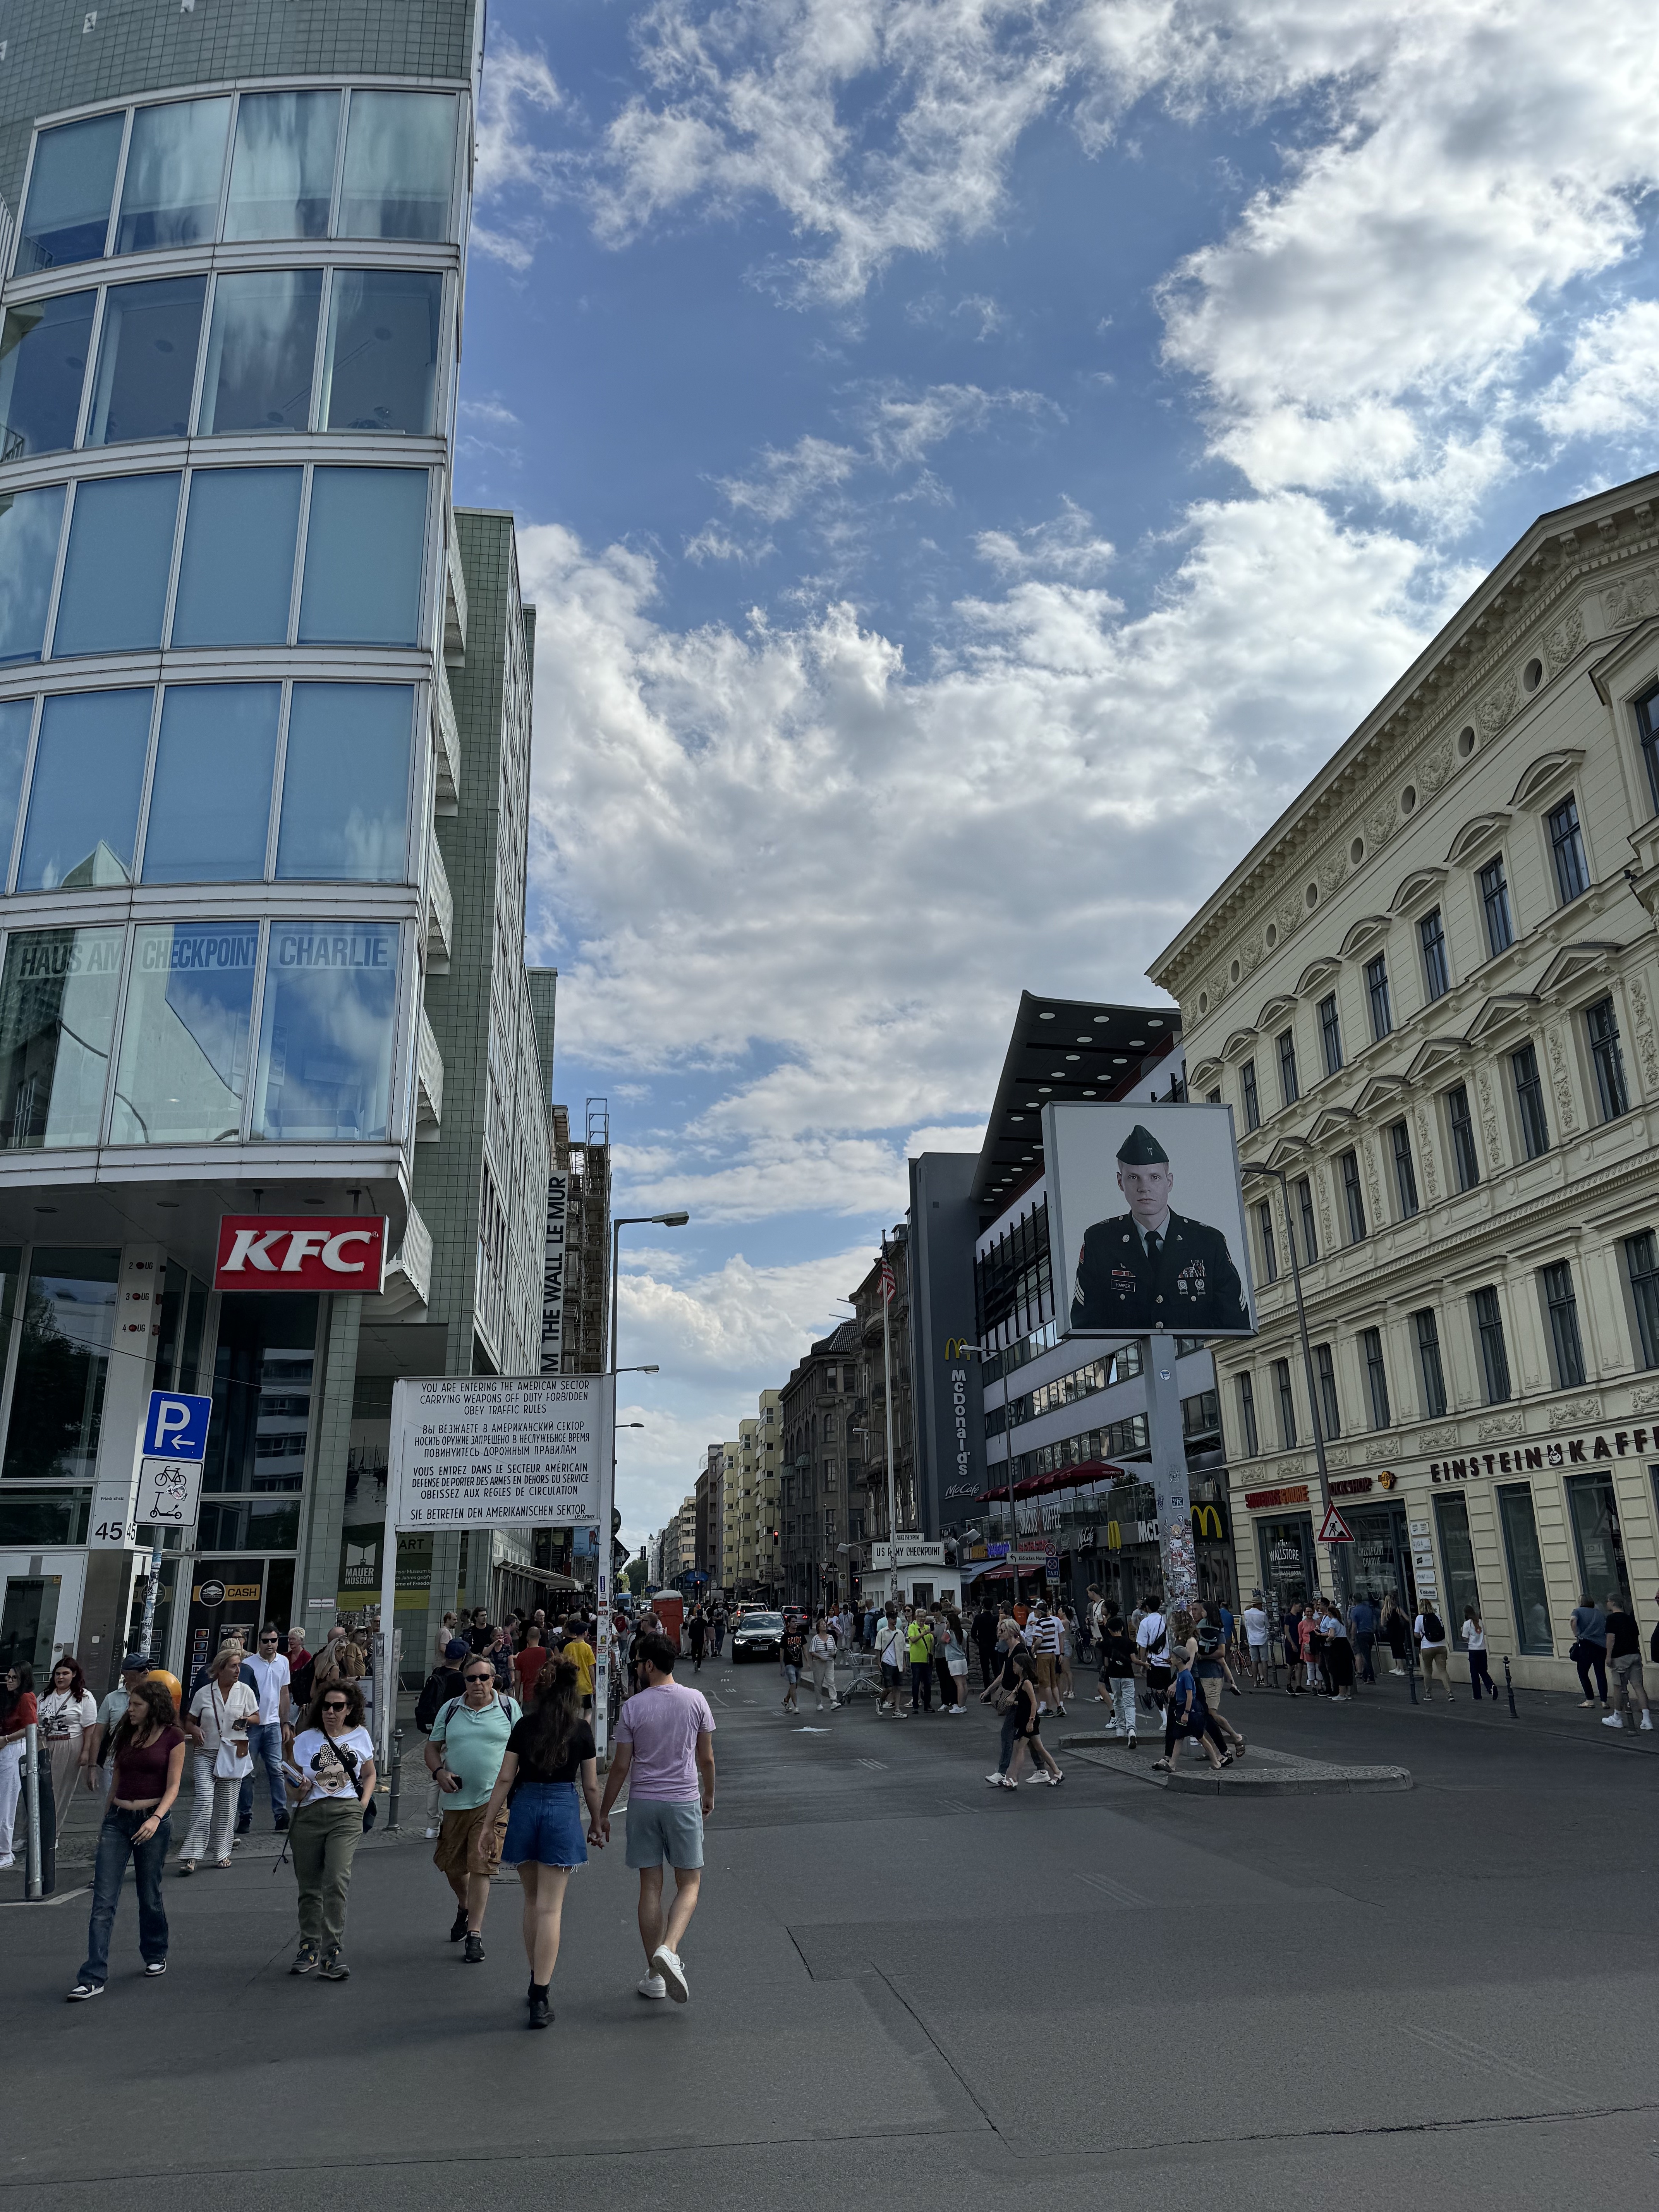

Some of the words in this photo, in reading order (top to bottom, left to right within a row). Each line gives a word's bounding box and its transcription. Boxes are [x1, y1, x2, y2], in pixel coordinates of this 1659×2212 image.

[21, 944, 82, 977] HAUS
[87, 941, 121, 972] AM
[142, 936, 258, 969] CHECKPOINT
[279, 936, 388, 967] CHARLIE
[548, 1176, 567, 1219] MUR
[546, 1224, 564, 1243] LE
[220, 1230, 372, 1272] KFC
[544, 1253, 563, 1302] WALL
[542, 1309, 560, 1343] THE
[422, 1383, 437, 1393] YOU
[441, 1382, 456, 1392] ARE
[460, 1382, 497, 1392] ENTERING
[501, 1381, 513, 1391] THE
[517, 1381, 556, 1391] AMERICAN
[560, 1380, 589, 1390] SECTOR
[420, 1394, 460, 1404] CARRYING
[464, 1393, 501, 1403] WEAPONS
[505, 1393, 519, 1403] OFF
[524, 1393, 543, 1402] DUTY
[546, 1391, 588, 1401] FORBIDDEN
[464, 1405, 485, 1415] OBEY
[489, 1405, 519, 1415] TRAFFIC
[523, 1404, 546, 1414] RULES
[154, 1401, 191, 1448] P
[423, 1424, 435, 1434] ВЫ
[483, 1424, 488, 1433] В
[556, 1421, 584, 1431] СЕКТОР
[415, 1436, 440, 1446] НОСИТЬ
[442, 1435, 469, 1445] ОРУЖИЕ
[512, 1434, 517, 1444] В
[519, 1433, 566, 1444] НЕСЛУЖЕБНОЕ
[568, 1432, 589, 1442] ВРЕМЯ
[483, 1446, 529, 1456] ДОРОЖНЫМ
[534, 1445, 577, 1455] ПРАВИЛАМ
[413, 1466, 434, 1476] VOUS
[439, 1465, 467, 1475] ENTREZ
[471, 1465, 492, 1474] DANS
[496, 1465, 503, 1474] LE
[507, 1463, 541, 1474] SECTEUR
[1430, 1446, 1542, 1482] EINSTEIN
[412, 1478, 440, 1488] DEFENSE
[441, 1478, 450, 1487] DE
[451, 1477, 475, 1486] PORTER
[476, 1476, 489, 1486] DES
[489, 1475, 511, 1486] ARMES
[513, 1475, 522, 1485] EN
[524, 1474, 549, 1484] DEHORS
[551, 1474, 560, 1484] DU
[562, 1474, 589, 1483] SERVICE
[1329, 1481, 1345, 1495] OCK
[421, 1489, 459, 1499] OBEISSEZ
[464, 1488, 480, 1498] AUX
[484, 1487, 511, 1497] REGLES
[515, 1487, 525, 1496] DE
[529, 1486, 577, 1496] CIRCULATION
[945, 1483, 980, 1498] McCafé
[410, 1509, 422, 1520] SIE
[427, 1508, 464, 1520] BETRETEN
[468, 1507, 483, 1518] DEN
[486, 1505, 553, 1518] AMERIKANISCHEN
[556, 1504, 586, 1515] SEKTOR
[1042, 1504, 1061, 1531] COFFEE
[95, 1522, 123, 1540] 45
[127, 1523, 136, 1540] 45
[398, 1539, 425, 1550] ART
[876, 1547, 885, 1556] US
[888, 1547, 904, 1556] AMY
[906, 1546, 940, 1556] CHECKPOINT
[1358, 1546, 1384, 1557] CHECKPOINT
[1269, 1549, 1300, 1562] WALLSTORE
[1363, 1557, 1381, 1568] CHARLIE
[345, 1568, 374, 1577] MAUER
[344, 1577, 373, 1585] MUSEUM
[228, 1588, 257, 1597] CASH
